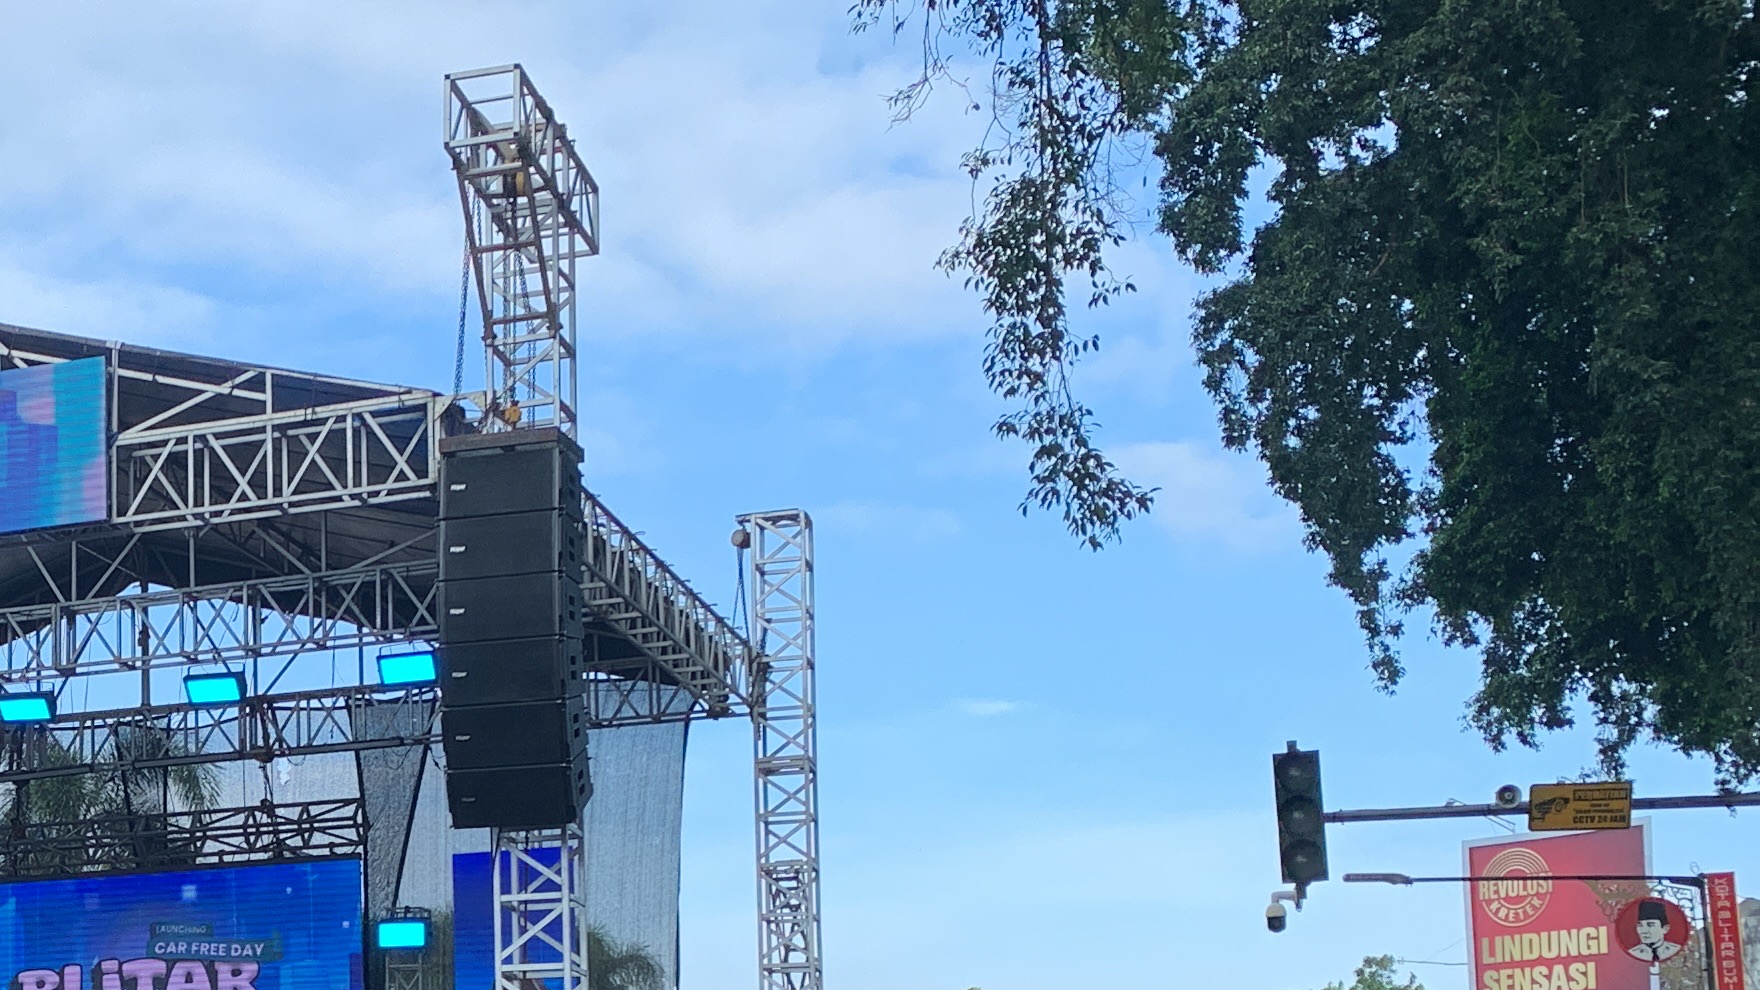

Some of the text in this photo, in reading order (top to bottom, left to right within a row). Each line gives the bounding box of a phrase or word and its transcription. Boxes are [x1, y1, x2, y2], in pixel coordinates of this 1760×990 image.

[1479, 872, 1553, 900] REVOLUSI
[1489, 896, 1544, 922] KRETEK
[154, 941, 265, 957] CAR FREE DAY
[1481, 926, 1609, 965] LINDUNGI
